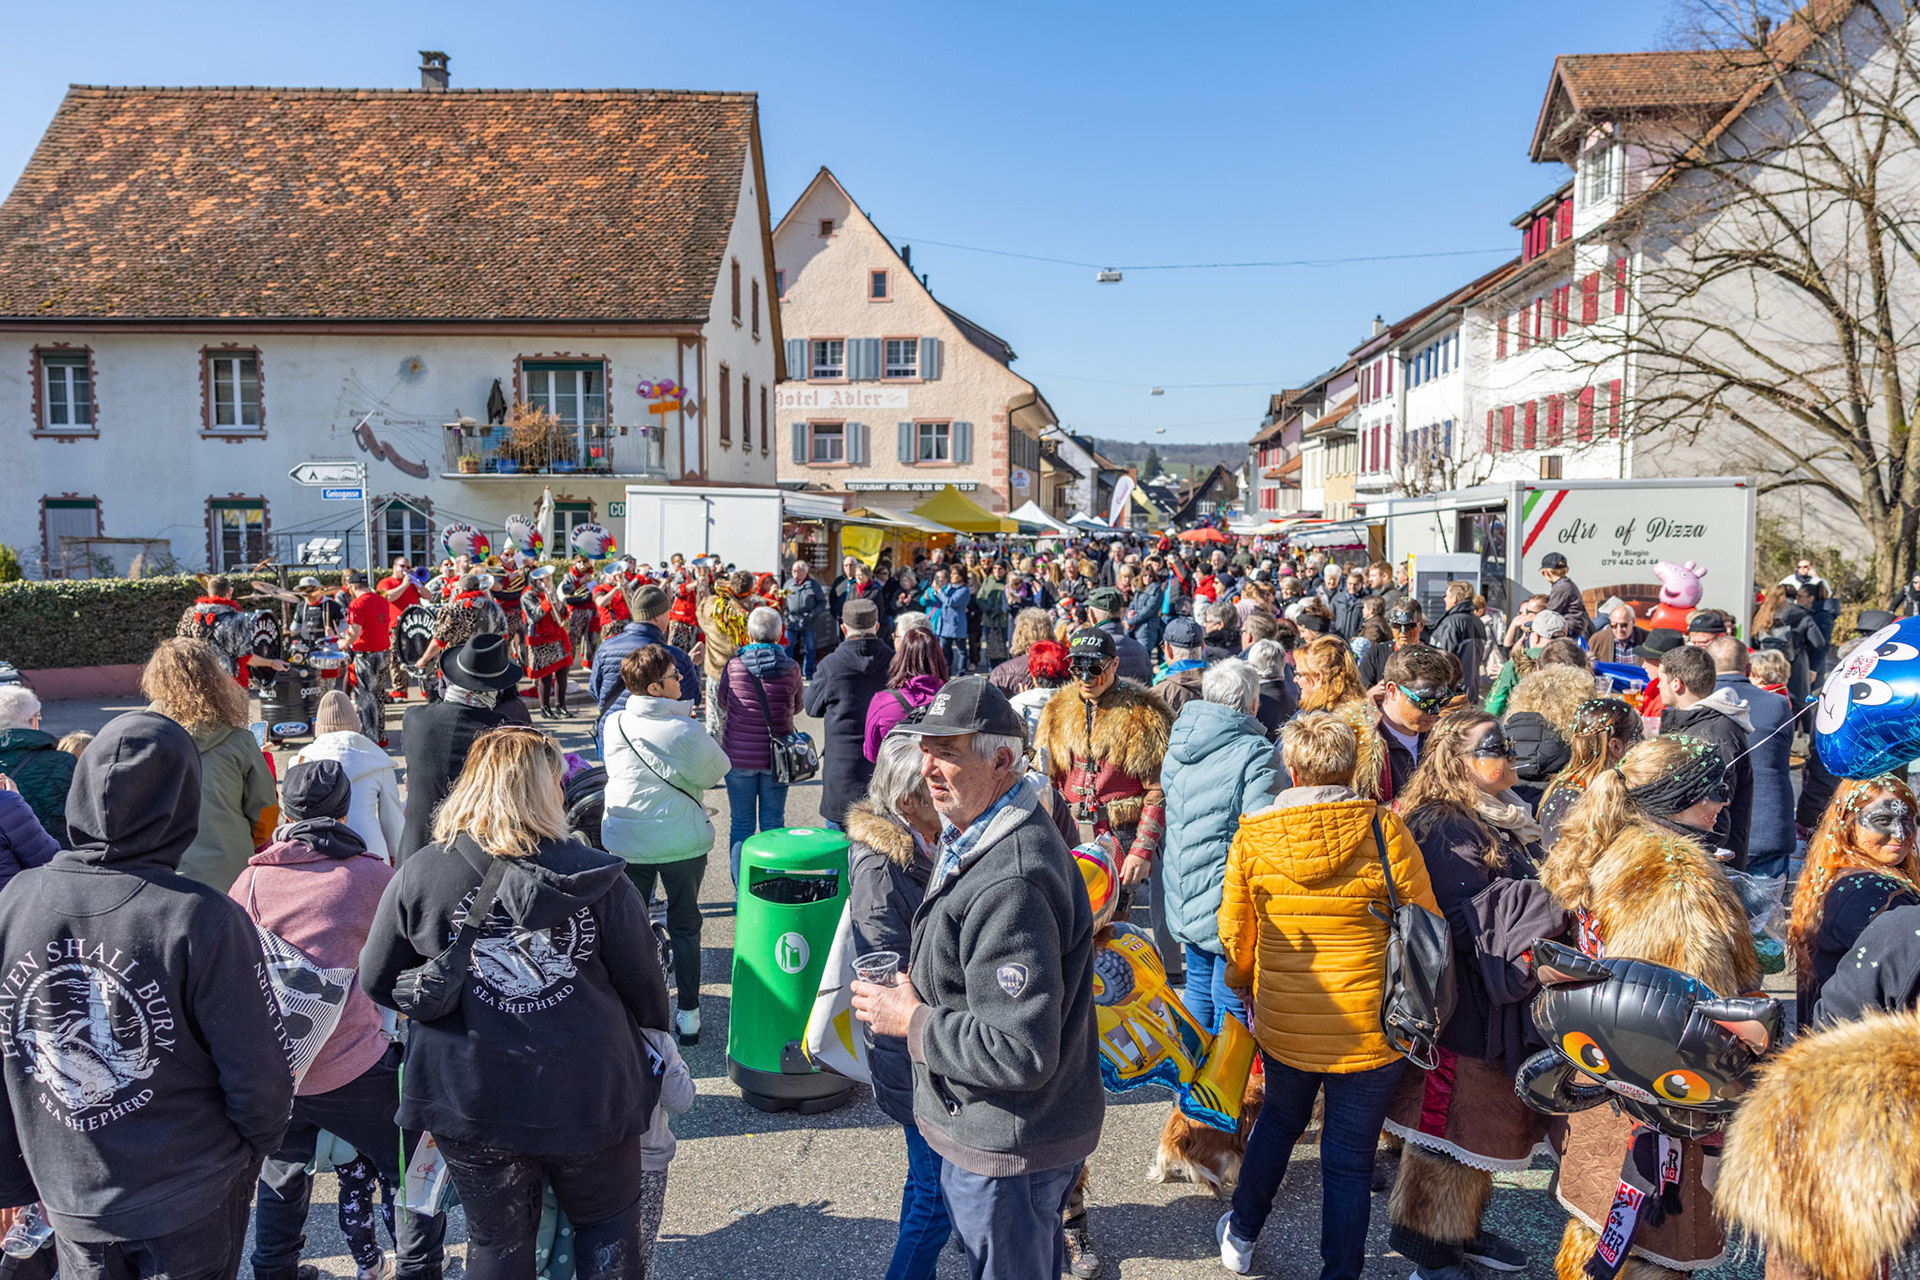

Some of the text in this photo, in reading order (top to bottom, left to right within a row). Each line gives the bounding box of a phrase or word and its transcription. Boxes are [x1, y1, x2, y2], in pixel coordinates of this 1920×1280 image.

[830, 389, 882, 408] Adler
[325, 490, 360, 500] Geissgasse
[846, 483, 887, 491] RESTAURANT
[889, 483, 910, 491] HOTEL
[912, 483, 932, 491] ADLER
[1558, 517, 1707, 546] Art of Pizza
[1611, 549, 1649, 557] by Biagio
[1080, 636, 1103, 647] FOX
[279, 724, 302, 733] Ford
[575, 905, 597, 962] BURN
[253, 961, 277, 1016] BURN
[1001, 981, 1021, 989] WEST
[46, 938, 140, 983] SHALL
[134, 979, 177, 1053] BURN
[472, 983, 575, 1015] SEA SHEPHERD
[38, 1088, 154, 1132] SEA SHEPHERD
